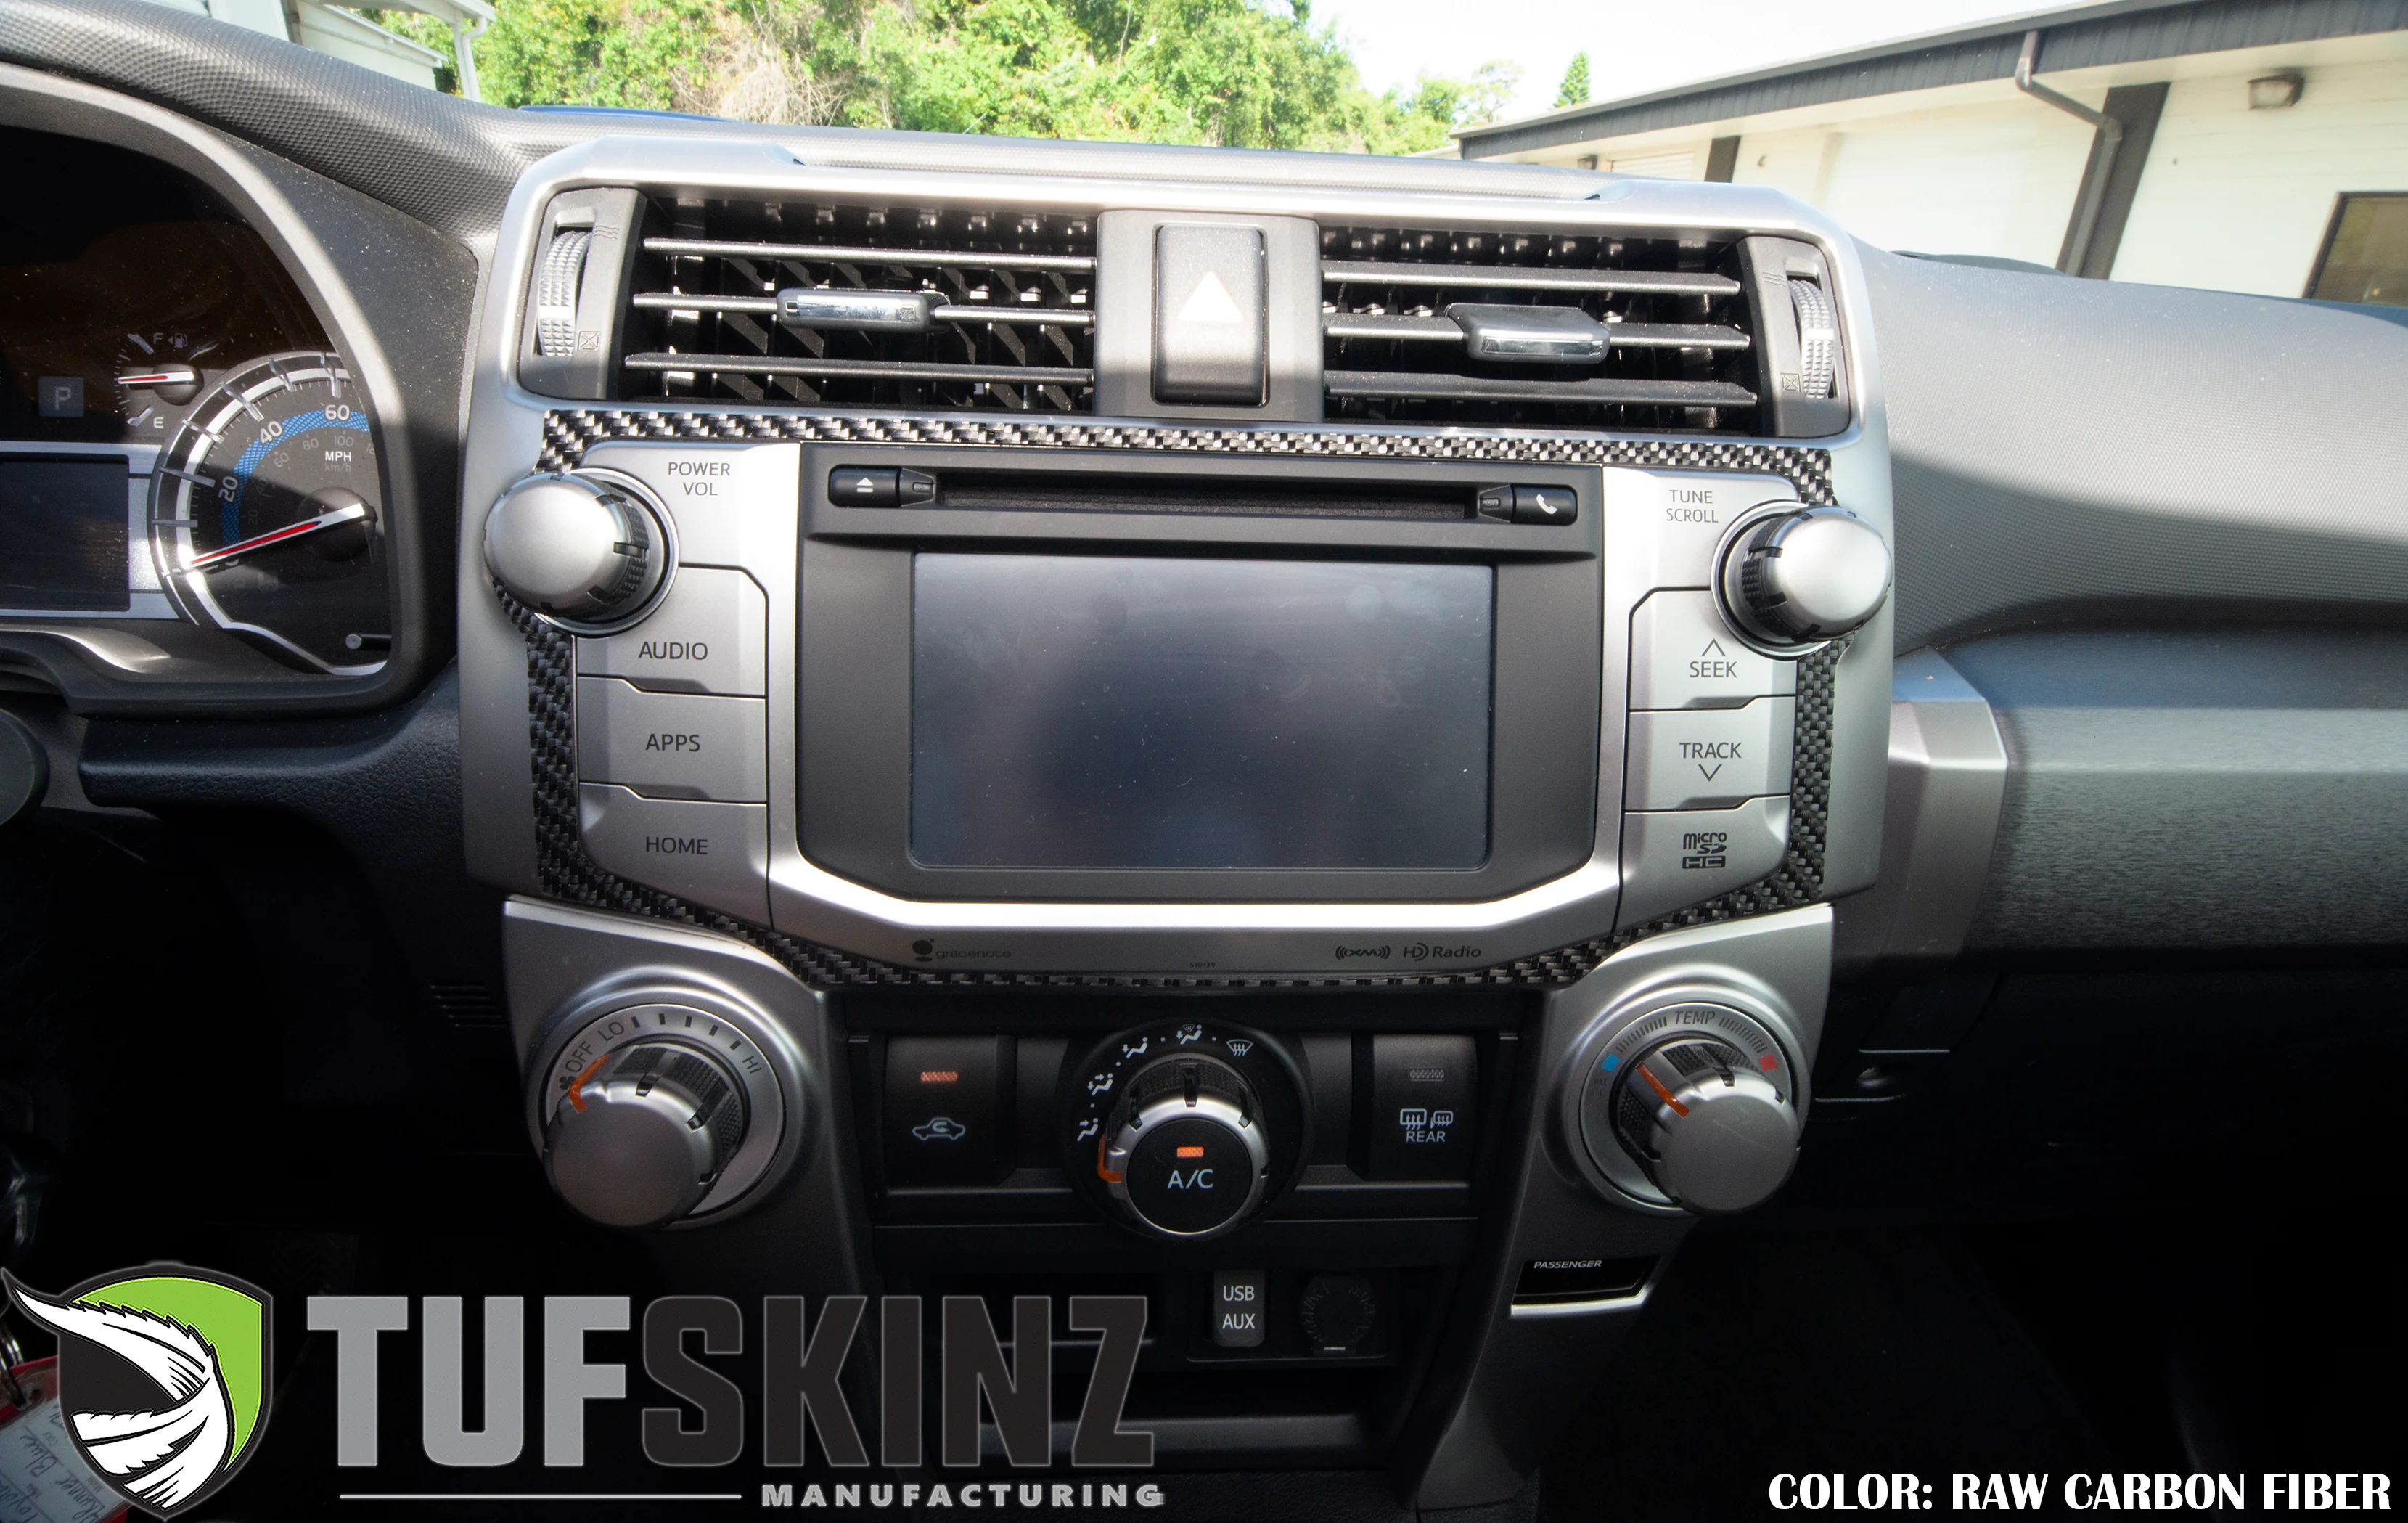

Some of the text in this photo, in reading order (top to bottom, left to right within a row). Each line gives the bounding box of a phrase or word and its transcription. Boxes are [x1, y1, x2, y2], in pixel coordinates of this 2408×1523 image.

[153, 332, 163, 345] F
[54, 386, 72, 410] P
[325, 404, 350, 420] 60
[153, 417, 163, 428] E
[260, 420, 282, 444] 40
[302, 438, 319, 450] 80
[334, 436, 353, 446] 100
[274, 452, 290, 467] 60
[325, 451, 351, 462] MPH
[324, 462, 351, 472] km/h
[668, 461, 731, 476] POWER
[218, 476, 239, 502] 20
[682, 481, 718, 497] VOL
[1669, 489, 1713, 504] TUNE
[1666, 508, 1719, 523] SCROLL
[638, 640, 709, 660] AUDIO
[1689, 661, 1737, 678] SEEK
[644, 733, 701, 753] APPS
[1679, 742, 1742, 759] TRACK
[645, 836, 708, 855] HOME
[1683, 832, 1727, 849] micro
[1684, 857, 1724, 868] HC
[935, 950, 1012, 960] gracenote
[1432, 945, 1482, 958] Radio
[1674, 1010, 1716, 1026] TEMP
[597, 1021, 625, 1042] LO
[565, 1040, 593, 1073] OFF
[742, 1055, 763, 1074] HI
[1405, 1130, 1446, 1143] REAR
[1167, 1168, 1214, 1191] A/C
[1533, 1259, 1602, 1270] PASSENGER
[1222, 1285, 1256, 1302] USB
[1221, 1314, 1256, 1331] AUX
